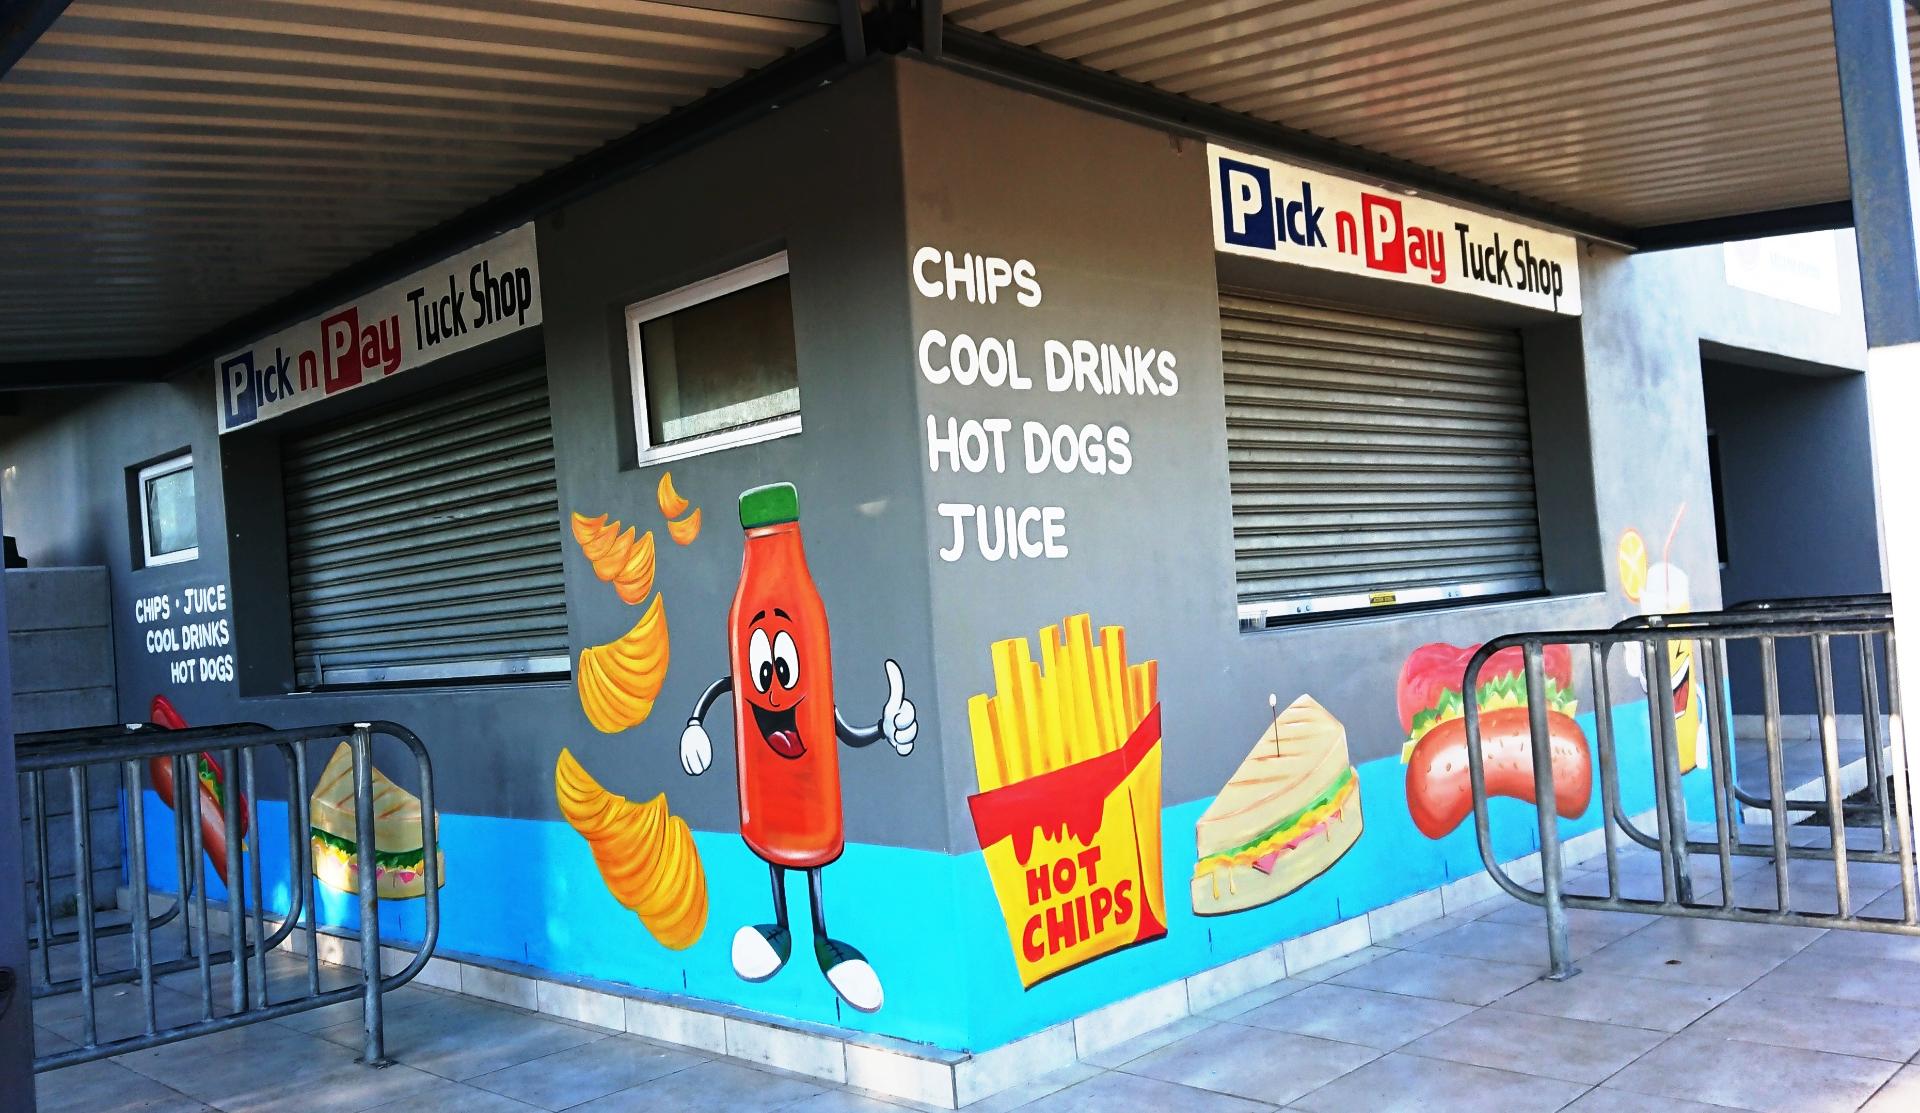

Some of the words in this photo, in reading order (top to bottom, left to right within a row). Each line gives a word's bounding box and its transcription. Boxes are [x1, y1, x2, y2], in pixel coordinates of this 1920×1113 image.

[1228, 168, 1328, 248] Pick
[1335, 210, 1358, 256] n
[1369, 202, 1447, 284] Pay
[1454, 222, 1513, 288] Tuck
[1513, 237, 1563, 311] Shop
[912, 246, 1043, 308] CHIPS
[228, 347, 295, 418] Pick
[298, 350, 319, 391] n
[327, 314, 403, 381] Pay
[406, 274, 468, 350] Tuck
[469, 259, 532, 329] Shop
[918, 329, 1033, 390] COOL
[1044, 339, 1179, 397] DRINKS
[926, 414, 1012, 474] HOT
[1022, 421, 1133, 475] DOGS
[937, 503, 1069, 562] JUICE
[135, 594, 171, 624] CHIPS
[183, 584, 227, 615] JUICE
[146, 628, 180, 654] COOL
[181, 619, 230, 651] DRINKS
[170, 659, 196, 684] HOT
[199, 654, 234, 683] DOGS
[1025, 845, 1102, 906] HOT
[1022, 879, 1134, 963] CHIPS
